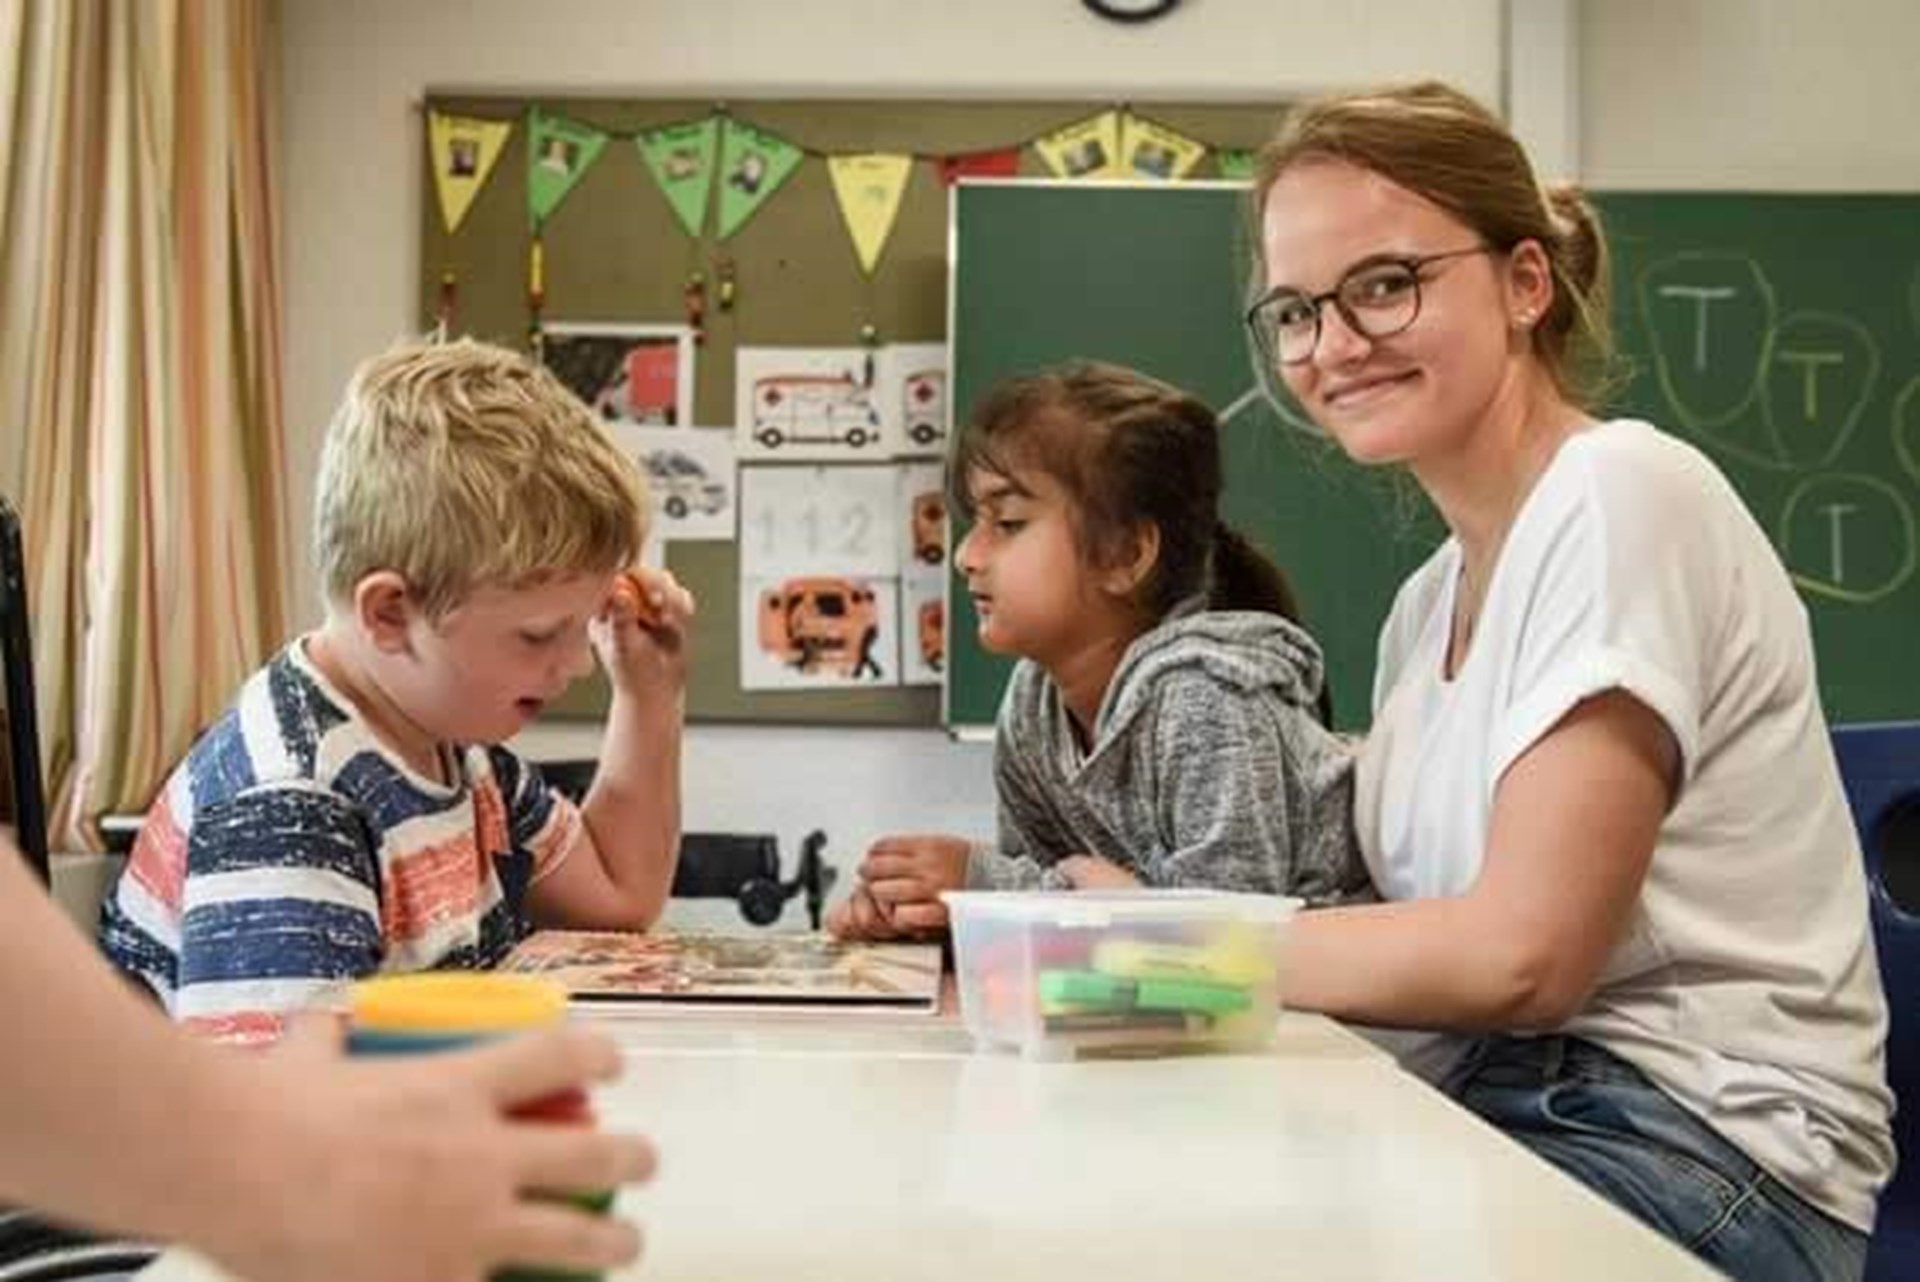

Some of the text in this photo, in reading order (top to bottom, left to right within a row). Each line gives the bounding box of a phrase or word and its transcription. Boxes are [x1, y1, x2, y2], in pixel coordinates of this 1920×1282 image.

[1659, 285, 1735, 372] T
[1776, 350, 1844, 419] T
[1817, 503, 1857, 583] T
